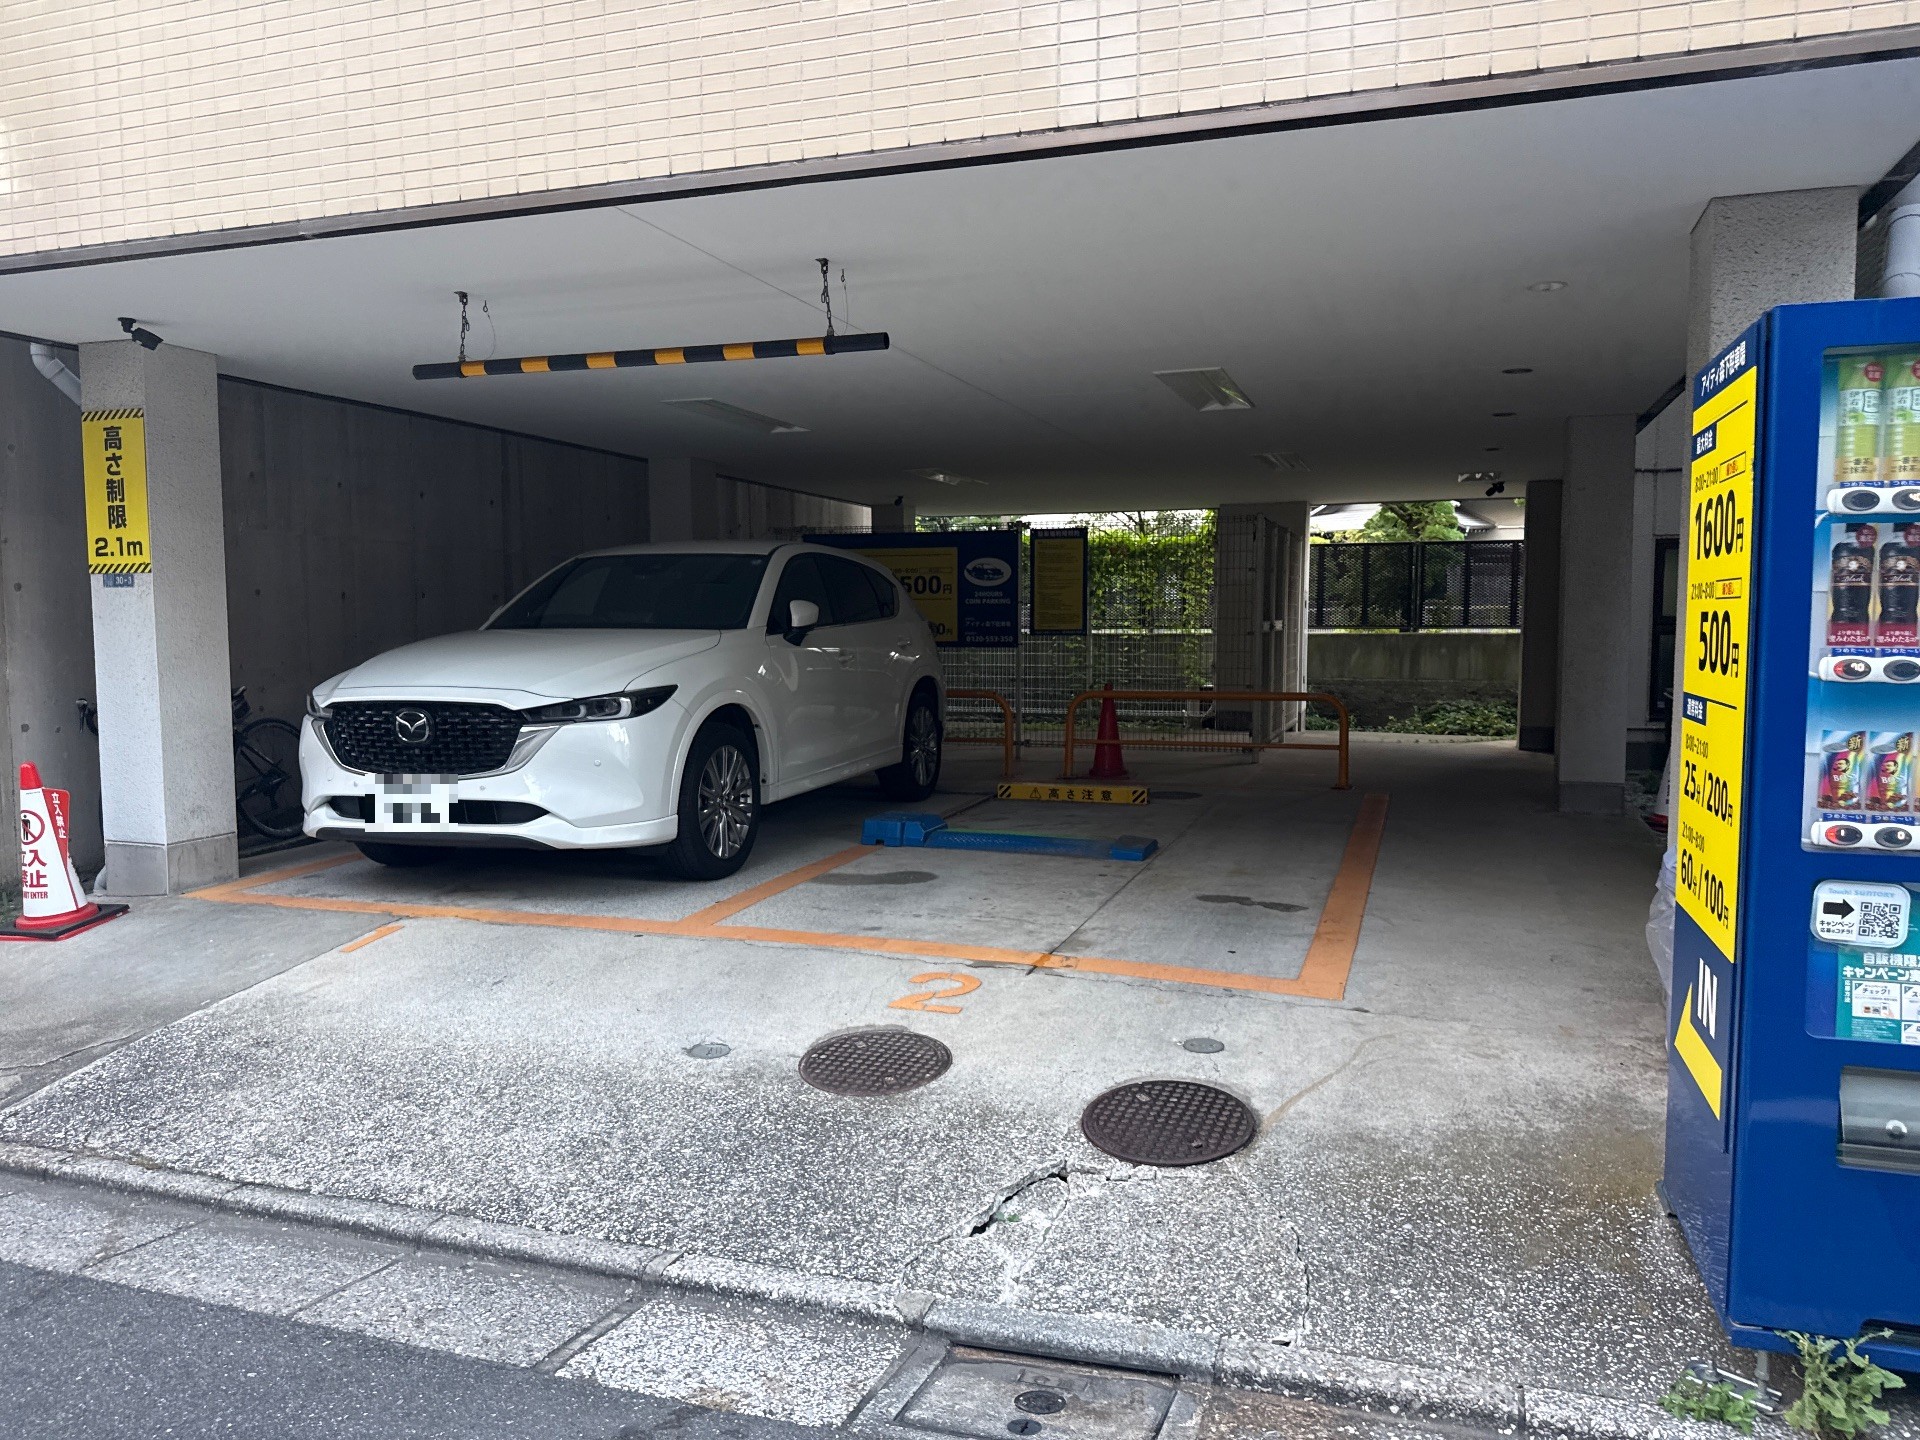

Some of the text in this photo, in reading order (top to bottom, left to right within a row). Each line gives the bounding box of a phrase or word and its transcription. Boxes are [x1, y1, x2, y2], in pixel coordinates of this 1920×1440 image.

[102, 425, 128, 530] 高さ制限
[1695, 489, 1744, 560] 1600円
[95, 536, 143, 557] 2.1m
[1698, 610, 1739, 678] 500円
[51, 792, 67, 839] 立入禁止
[1048, 788, 1113, 801] 高さ注意
[30, 891, 48, 899] ENTER
[1819, 920, 1855, 928] キャンペーン
[1863, 952, 1920, 968] 自販機限
[887, 971, 982, 1014] 2
[1697, 957, 1718, 1040] IN
